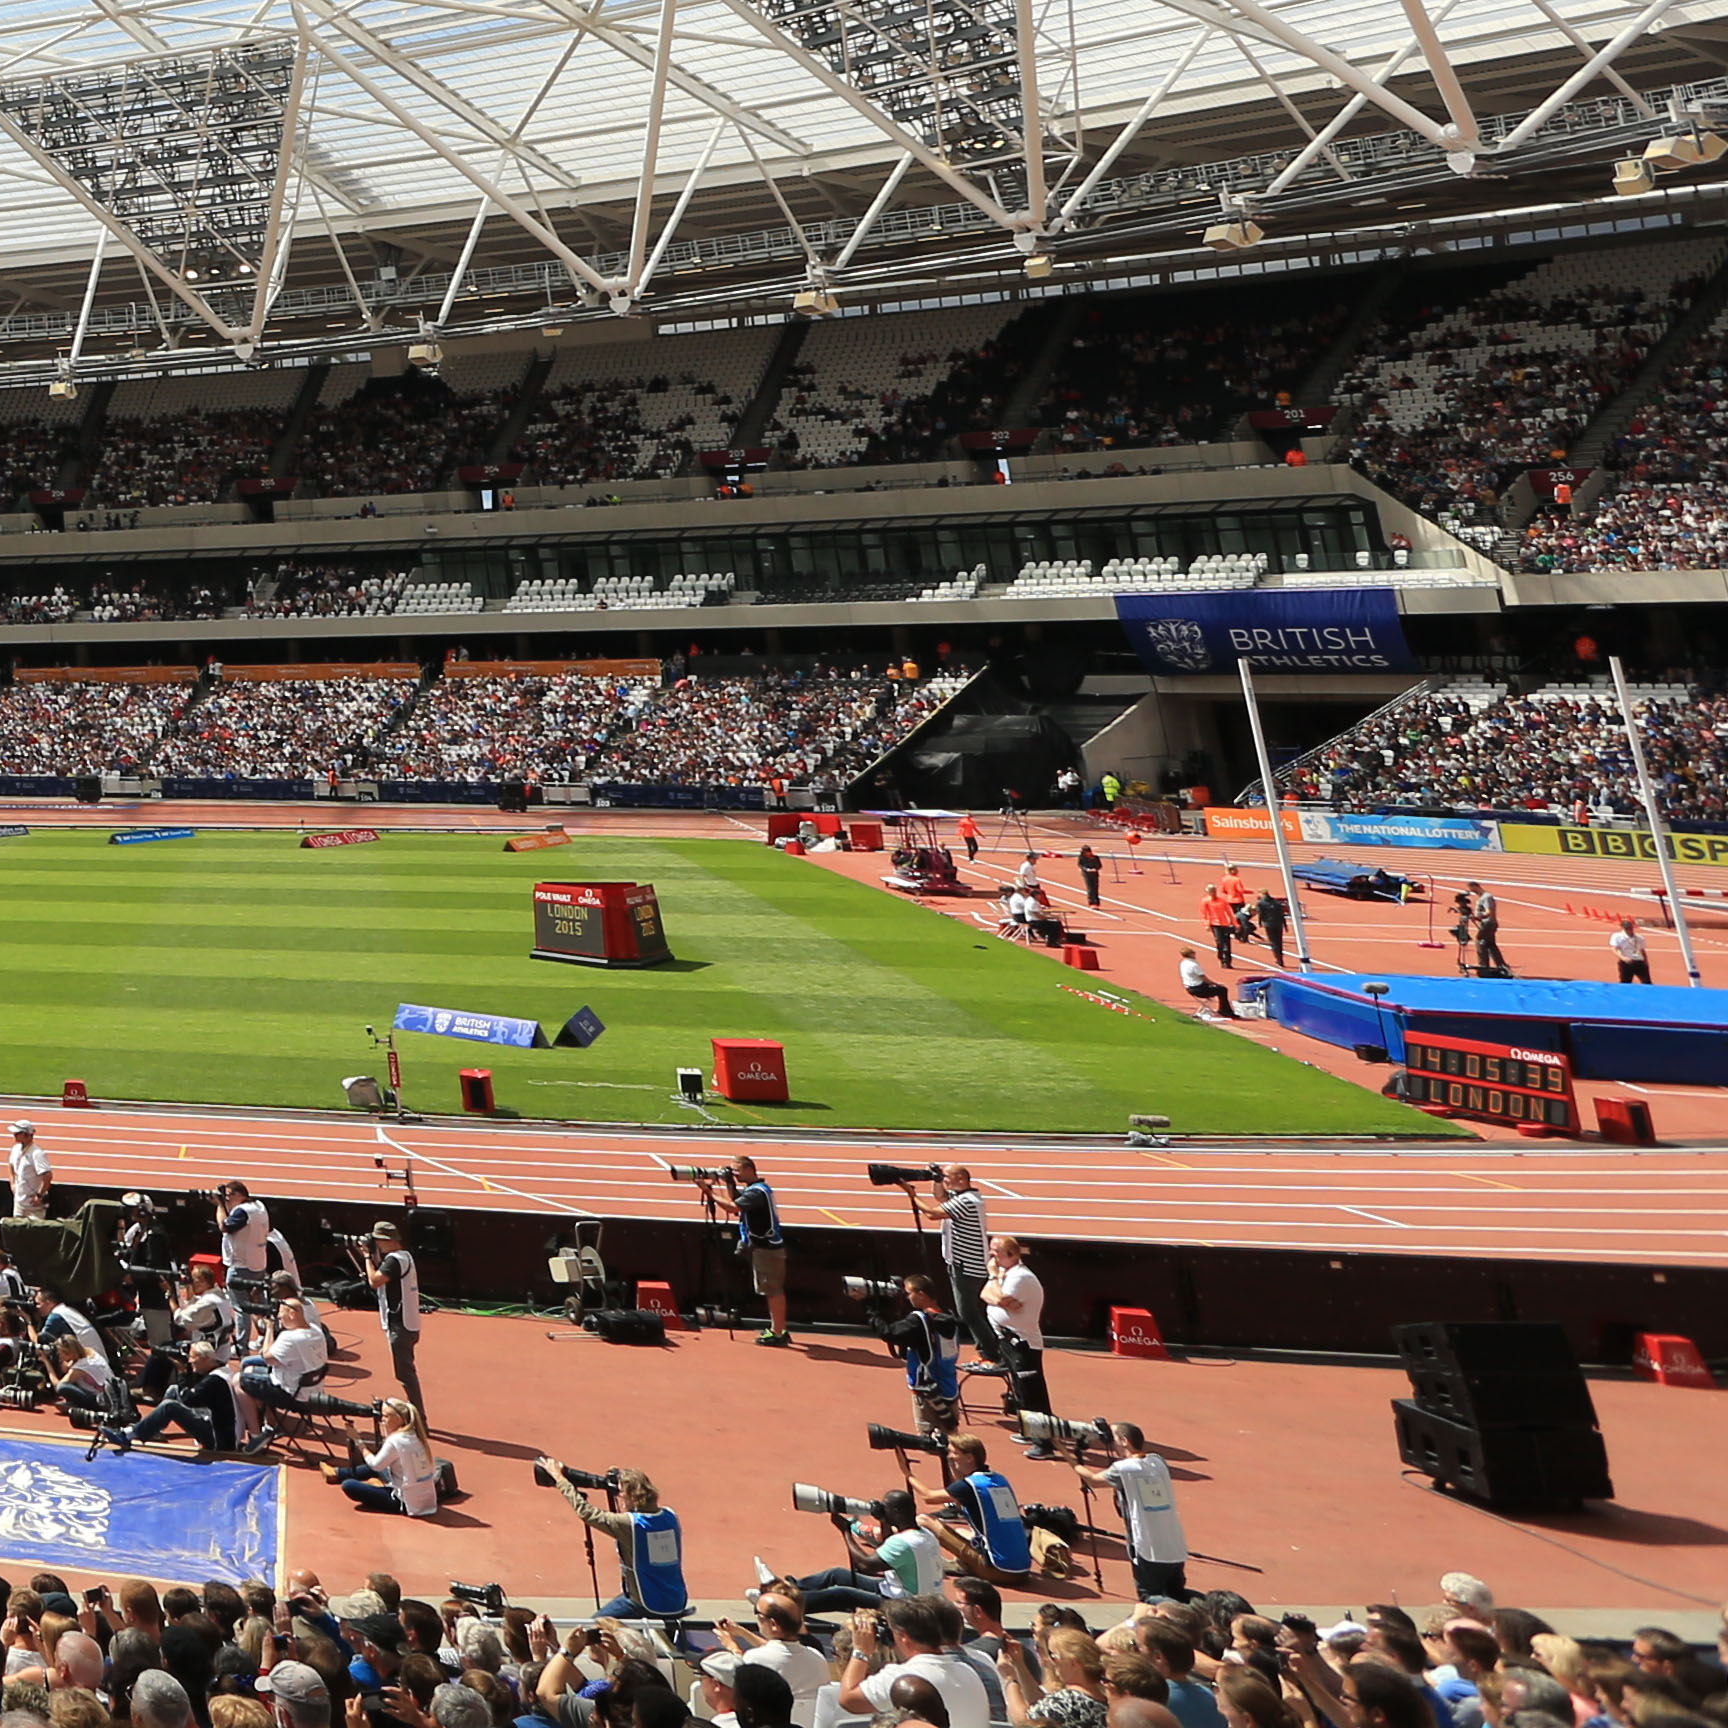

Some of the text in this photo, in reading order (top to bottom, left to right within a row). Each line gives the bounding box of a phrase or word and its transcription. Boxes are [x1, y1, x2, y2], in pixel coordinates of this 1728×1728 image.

[991, 431, 1010, 440] 202
[1548, 471, 1575, 482] 256
[1229, 627, 1376, 650] BRITISH
[1241, 655, 1390, 667] ATHLETICS
[1337, 823, 1481, 841] THE NATIONAL LOTTERY
[535, 891, 551, 901] POLE
[577, 897, 601, 905] OMEGA
[546, 903, 588, 921] LONDON
[555, 920, 582, 936] 2015
[455, 1017, 492, 1029] BRITISH
[452, 1025, 489, 1037] ATHLETICS
[1521, 1050, 1562, 1066] OMEGA
[737, 1071, 778, 1081] OMEGA
[1429, 1079, 1545, 1122] LONDON
[1119, 1335, 1161, 1347] OMEGA
